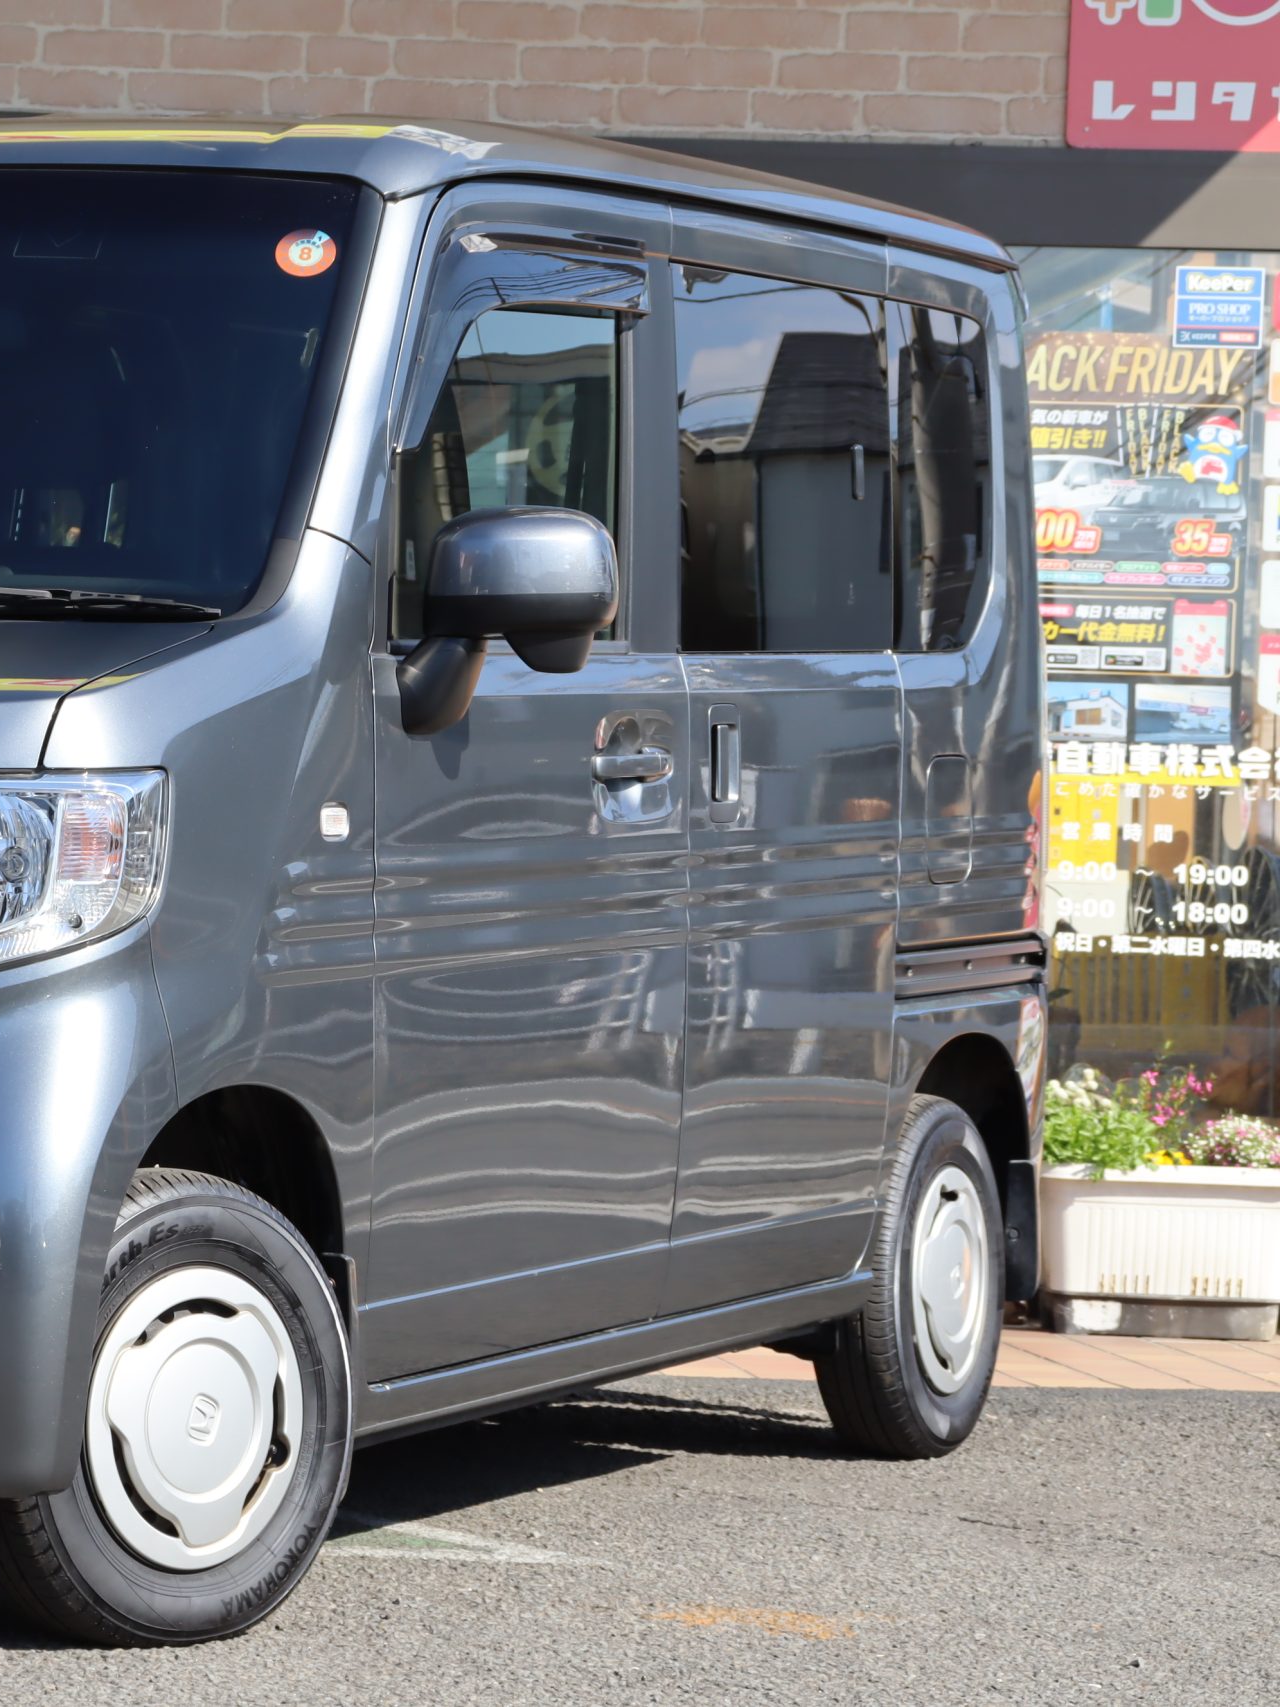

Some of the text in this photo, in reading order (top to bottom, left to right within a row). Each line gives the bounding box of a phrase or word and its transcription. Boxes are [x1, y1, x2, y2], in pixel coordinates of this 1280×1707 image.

[1091, 80, 1280, 121] レンタ
[299, 246, 312, 261] 8
[1186, 272, 1254, 293] KeePer
[1189, 302, 1252, 316] PRO SHOP
[1104, 345, 1244, 396] FRIDAY
[1048, 741, 1280, 780] 自動車株式会
[1061, 821, 1174, 844] 営業時間
[1058, 861, 1118, 882] 9:00
[1173, 864, 1249, 887] 19:00
[1056, 898, 1116, 919] 9:00
[1172, 902, 1249, 925] 18:00
[221, 1522, 318, 1618] YOKOHAMA
